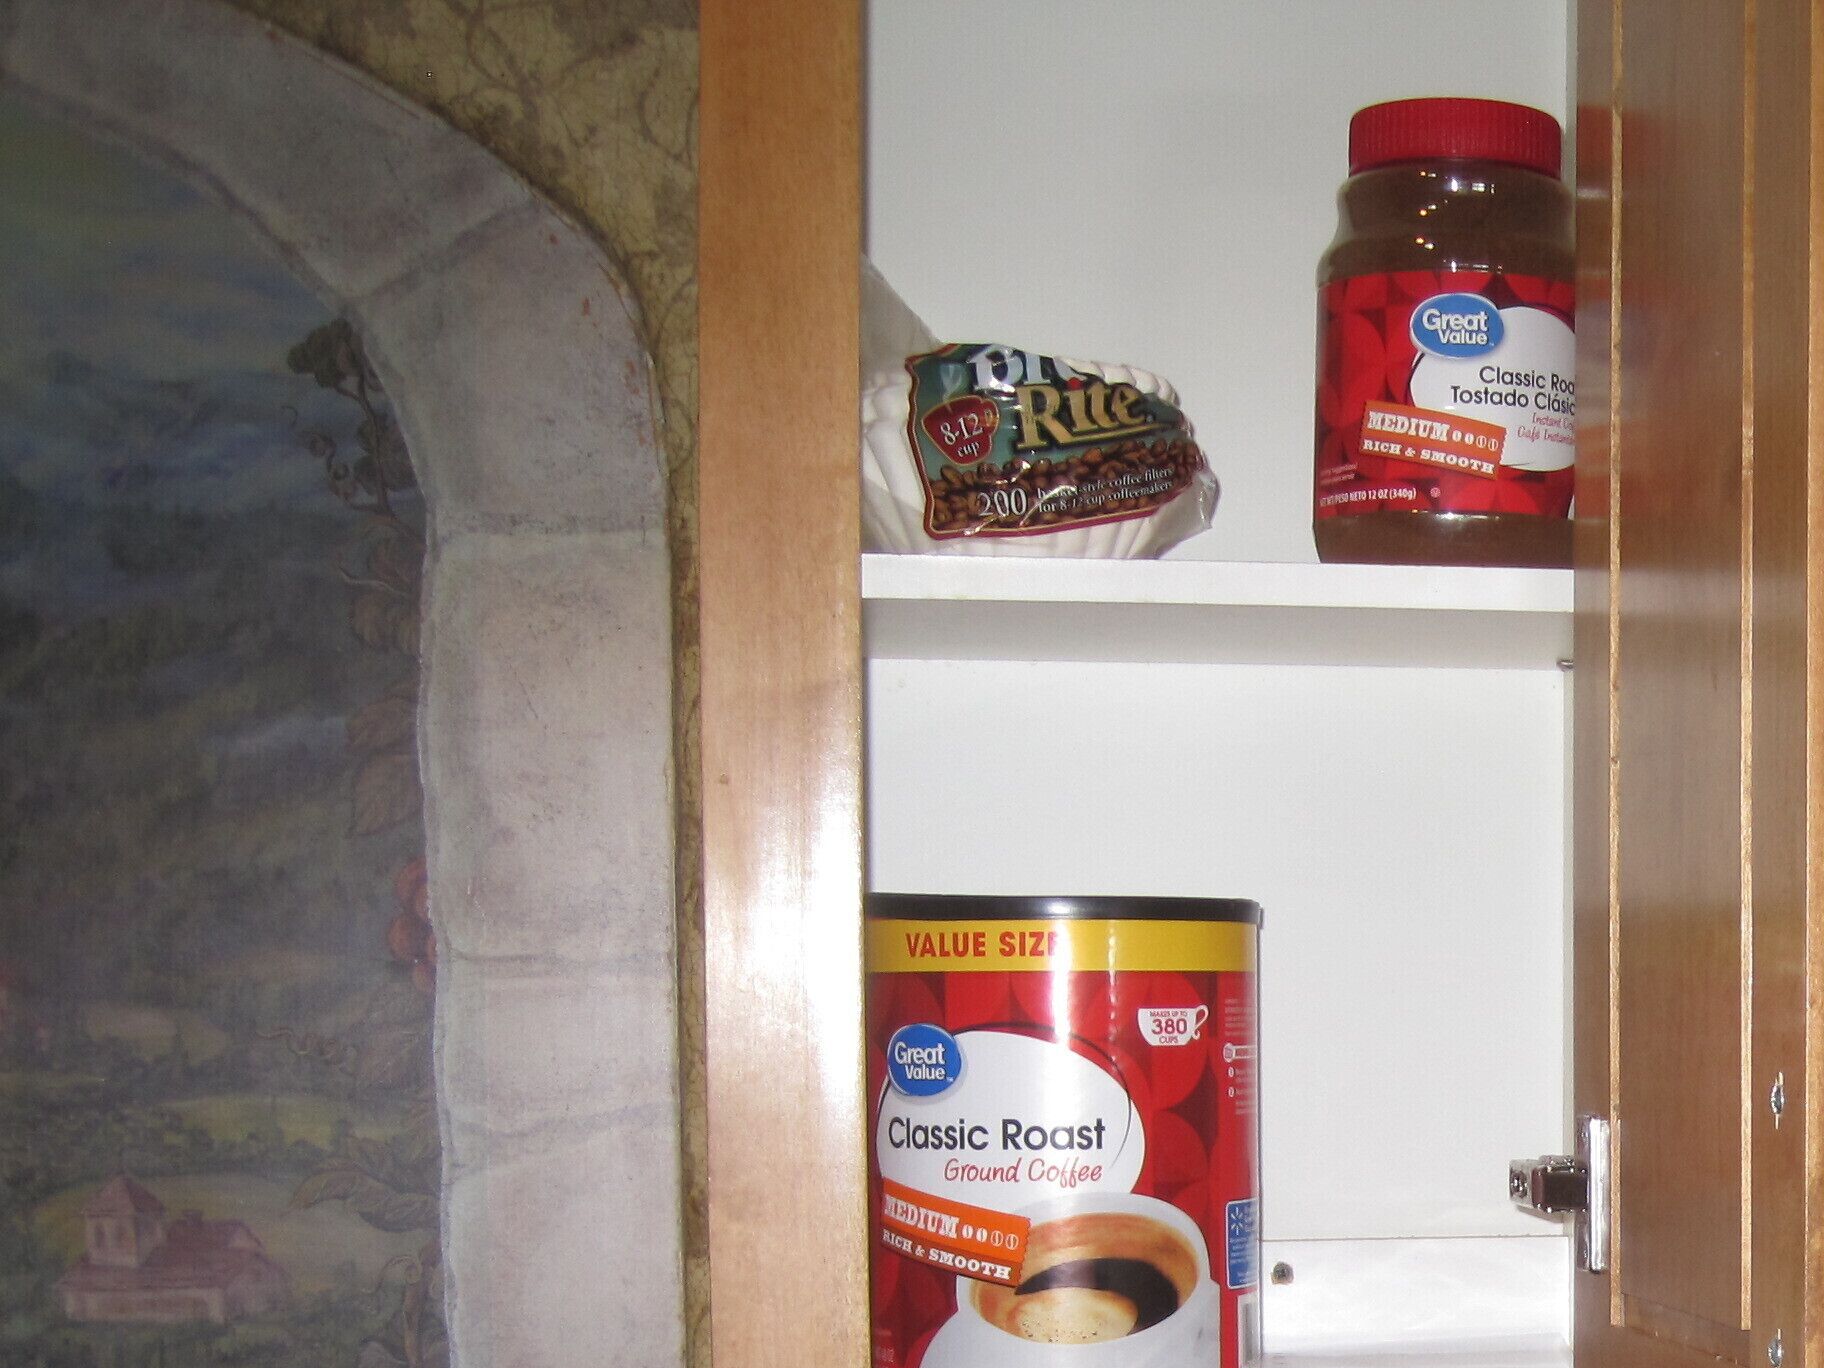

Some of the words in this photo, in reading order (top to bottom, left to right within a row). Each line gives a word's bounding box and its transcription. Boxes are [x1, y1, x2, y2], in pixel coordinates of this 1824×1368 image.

[1422, 309, 1488, 332] Great
[1438, 329, 1488, 345] Value
[1479, 365, 1546, 389] Classic
[1451, 385, 1529, 408] Tostado
[1534, 392, 1576, 416] Clásic
[1016, 380, 1146, 450] Rite
[1367, 410, 1451, 442] MEDIUM
[939, 413, 984, 446] 8-12
[957, 440, 979, 459] cup
[1362, 438, 1401, 456] RICH
[1404, 446, 1416, 458] &
[1420, 448, 1495, 475] SMOOTH
[977, 487, 1027, 516] 200
[1368, 489, 1377, 500] 12
[1378, 488, 1388, 499] OZ
[1389, 487, 1417, 500] (340g)
[905, 931, 986, 958] VALUE
[1151, 1018, 1188, 1035] 380
[1159, 1035, 1179, 1043] CUPS
[894, 1041, 945, 1065] Great
[904, 1064, 946, 1081] Value
[888, 1116, 989, 1150] Classic
[1002, 1118, 1106, 1151] Roast
[944, 1157, 1022, 1182] Ground
[1028, 1156, 1102, 1188] Coffee
[885, 1194, 960, 1239] MEDIUM
[882, 1228, 913, 1256] RICH
[914, 1244, 925, 1257] &
[928, 1247, 1012, 1280] SMOOTH
